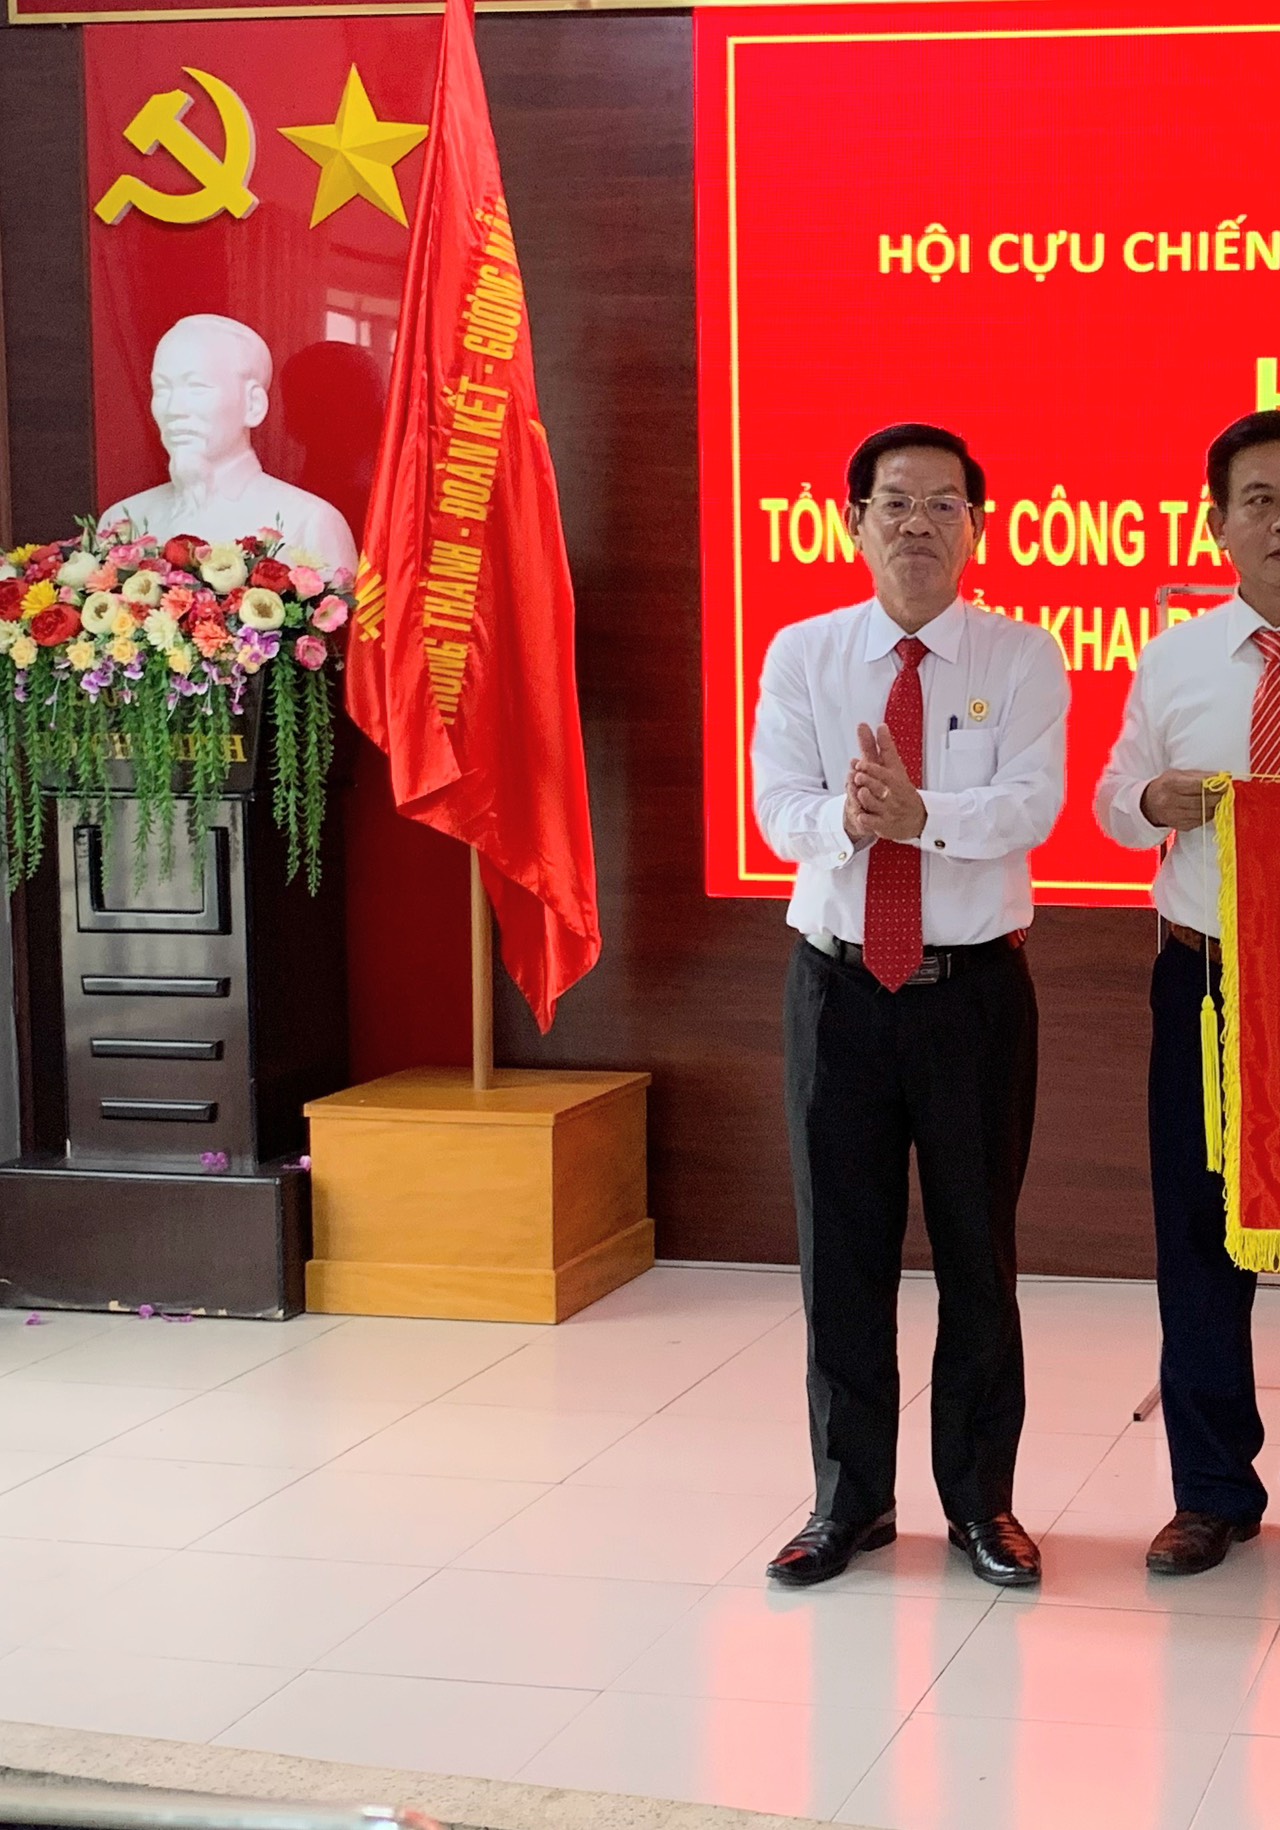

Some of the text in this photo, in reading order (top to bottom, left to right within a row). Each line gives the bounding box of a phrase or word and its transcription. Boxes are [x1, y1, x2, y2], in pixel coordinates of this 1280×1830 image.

[878, 223, 971, 283] HỘI
[988, 231, 1106, 282] CỰU
[461, 264, 525, 361] GƯƠNG
[442, 375, 509, 440] KẾT
[435, 438, 500, 522] ĐOÀN
[760, 482, 856, 565] TỔN
[1009, 484, 1146, 567] CÔNG
[1159, 484, 1226, 567] TÁ
[418, 539, 483, 632] THÀNH
